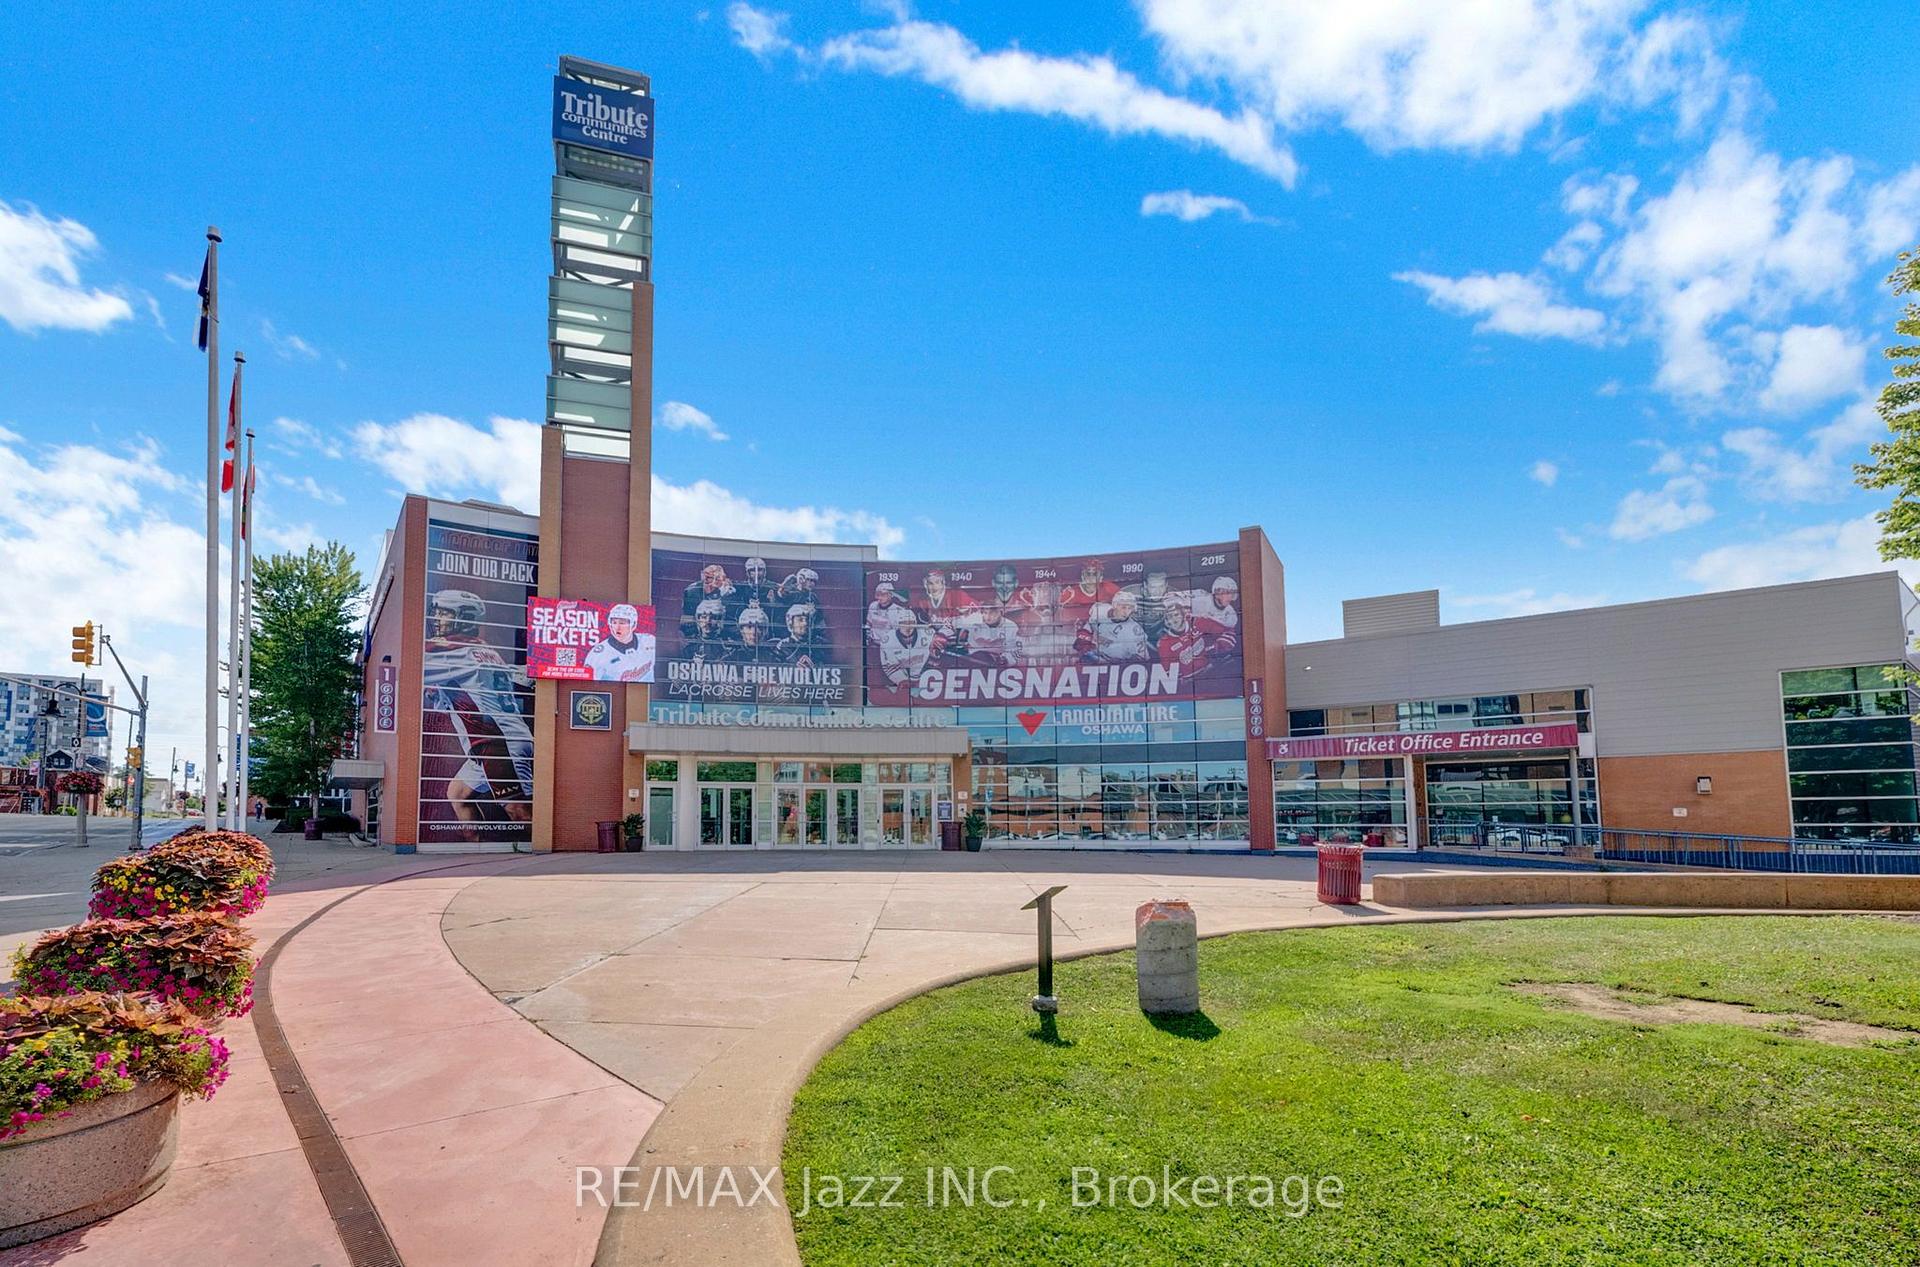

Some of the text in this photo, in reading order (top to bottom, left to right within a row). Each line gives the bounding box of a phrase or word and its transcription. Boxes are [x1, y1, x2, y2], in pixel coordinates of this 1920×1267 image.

[561, 91, 649, 130] Tribute
[562, 112, 647, 139] communities
[437, 553, 534, 583] JOIN OUR PACK
[1122, 563, 1144, 573] 1990
[1201, 555, 1225, 567] 2015
[879, 572, 899, 582] 1939
[951, 572, 973, 582] 1940
[1035, 569, 1056, 579] 1944
[532, 607, 599, 629] SEASON
[532, 625, 600, 646] TICKETS
[384, 668, 390, 681] 1
[668, 661, 738, 683] OSHAWA
[743, 665, 841, 686] FIREWOLVES
[919, 663, 1179, 700] GENSNATION
[669, 683, 845, 700] LACROSSE LIVES HERE
[1251, 680, 1258, 693] 1
[380, 683, 394, 728] GATE
[653, 704, 734, 726] Tribute
[1053, 705, 1179, 724] CANADIAN TIRE
[1082, 724, 1146, 735] OSHAWA
[1344, 731, 1544, 753] Ticket Office Entrance
